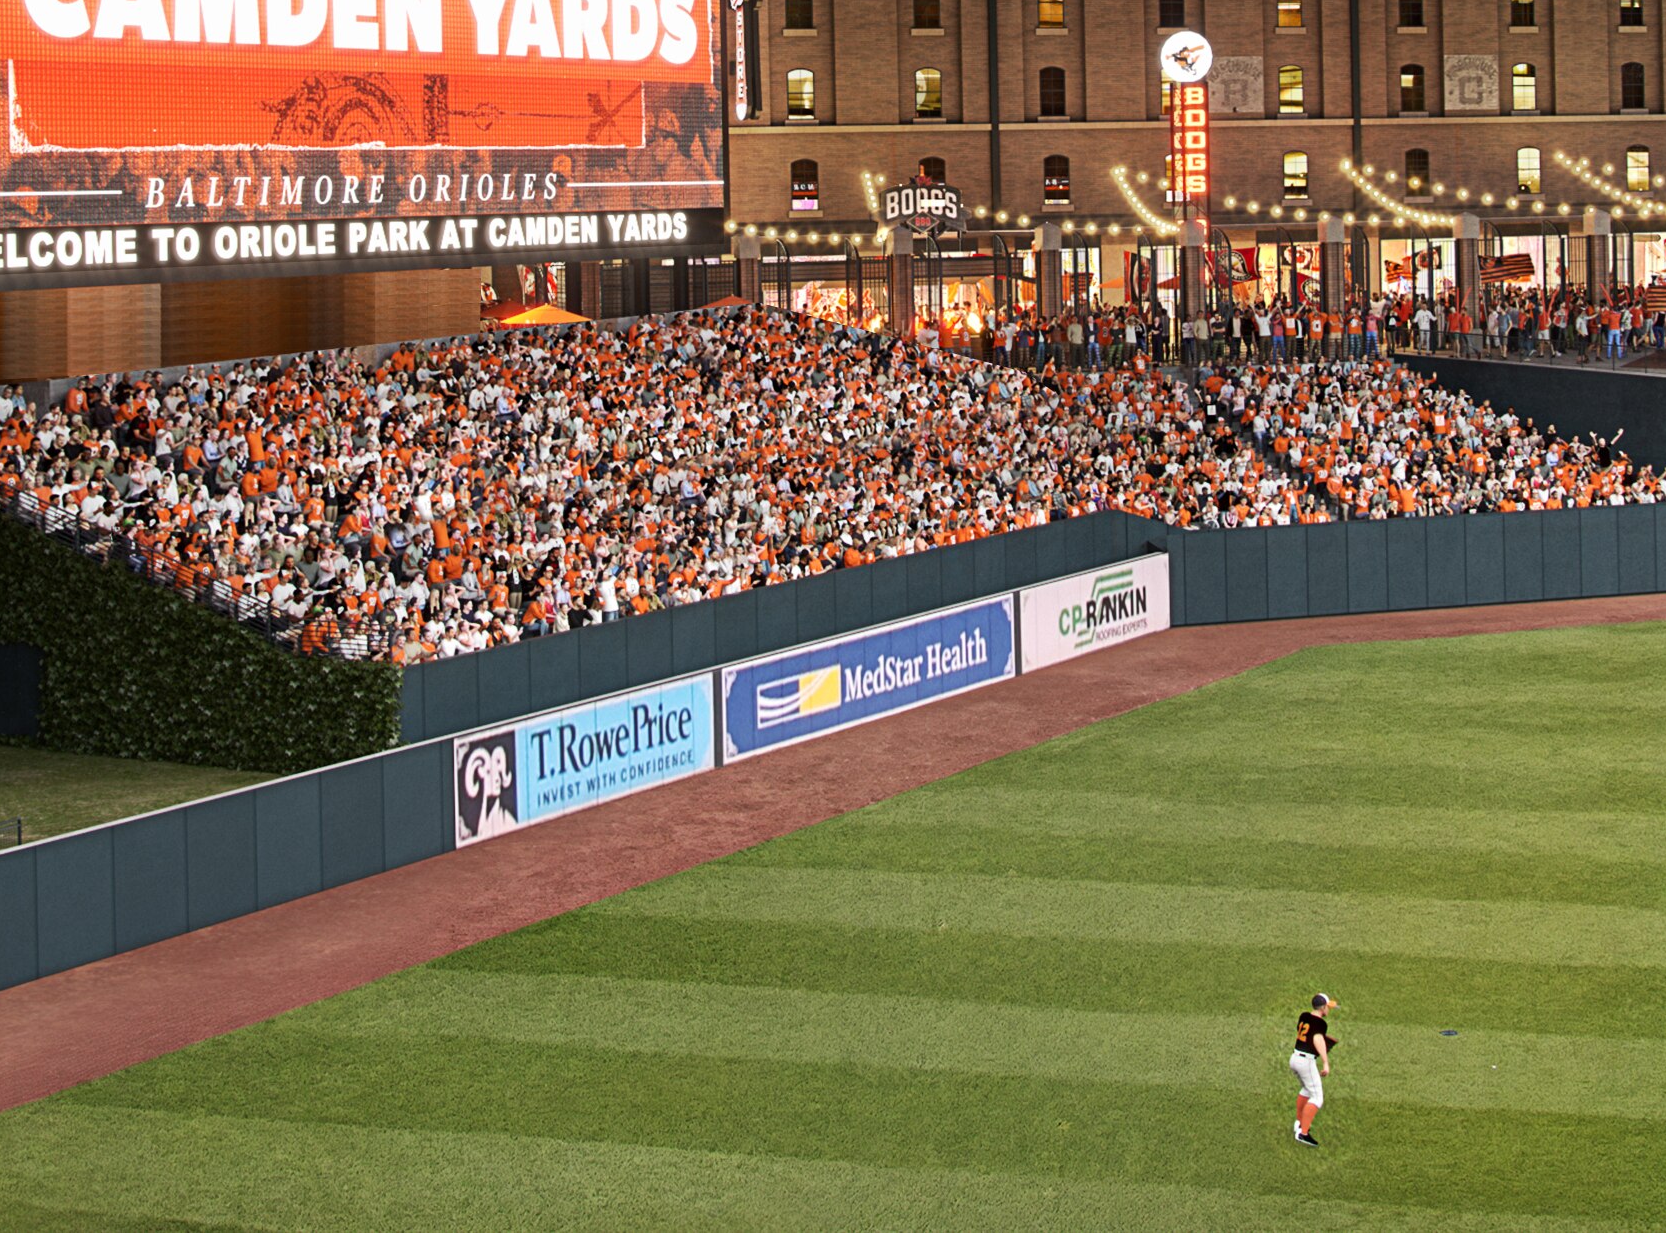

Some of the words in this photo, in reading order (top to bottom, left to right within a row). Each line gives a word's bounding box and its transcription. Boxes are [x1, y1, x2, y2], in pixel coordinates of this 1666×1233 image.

[736, 12, 745, 100] STORE
[144, 174, 388, 209] BALTIMORE
[410, 172, 559, 202] ORIOLES
[886, 187, 958, 219] BOOG'S
[151, 226, 201, 263] TO
[213, 223, 336, 260] ORIOLE
[349, 221, 430, 254] PARK
[440, 219, 477, 248] AT
[488, 214, 599, 247] CAMDEN
[607, 212, 687, 242] YARDS
[1096, 625, 1122, 641] ROOFING
[1122, 617, 1148, 635] EXPERTS
[844, 654, 924, 703] MedStar
[926, 626, 988, 680] Health
[537, 781, 581, 807] INVEST
[587, 775, 617, 792] WITH
[620, 749, 695, 783] CONFIDENCE
